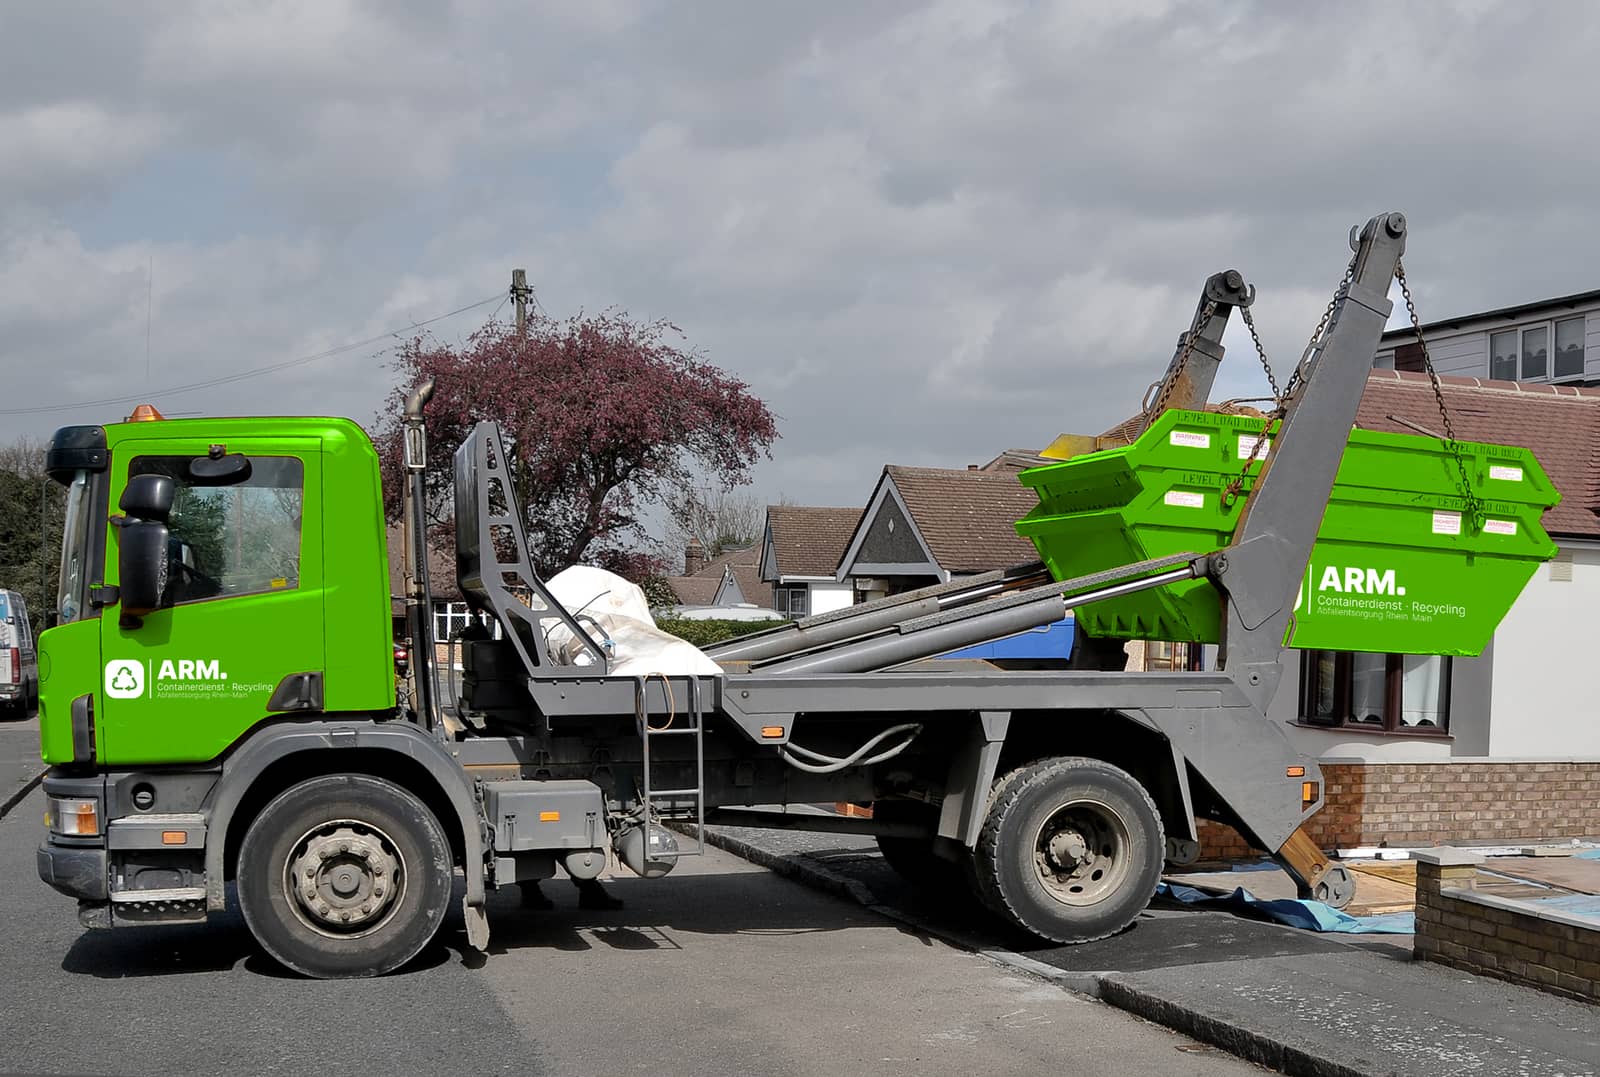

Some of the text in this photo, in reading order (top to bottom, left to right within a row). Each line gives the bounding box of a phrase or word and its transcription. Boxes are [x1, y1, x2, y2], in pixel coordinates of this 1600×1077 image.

[1177, 411, 1209, 424] LEVEL
[1213, 415, 1240, 427] LOAD
[1183, 473, 1215, 486] LEVEL
[1318, 566, 1406, 596] ARM.
[1317, 595, 1466, 618] Containerdienst Recycling
[157, 659, 228, 681] ARM.
[157, 683, 273, 692] Containerdienst Recycling
